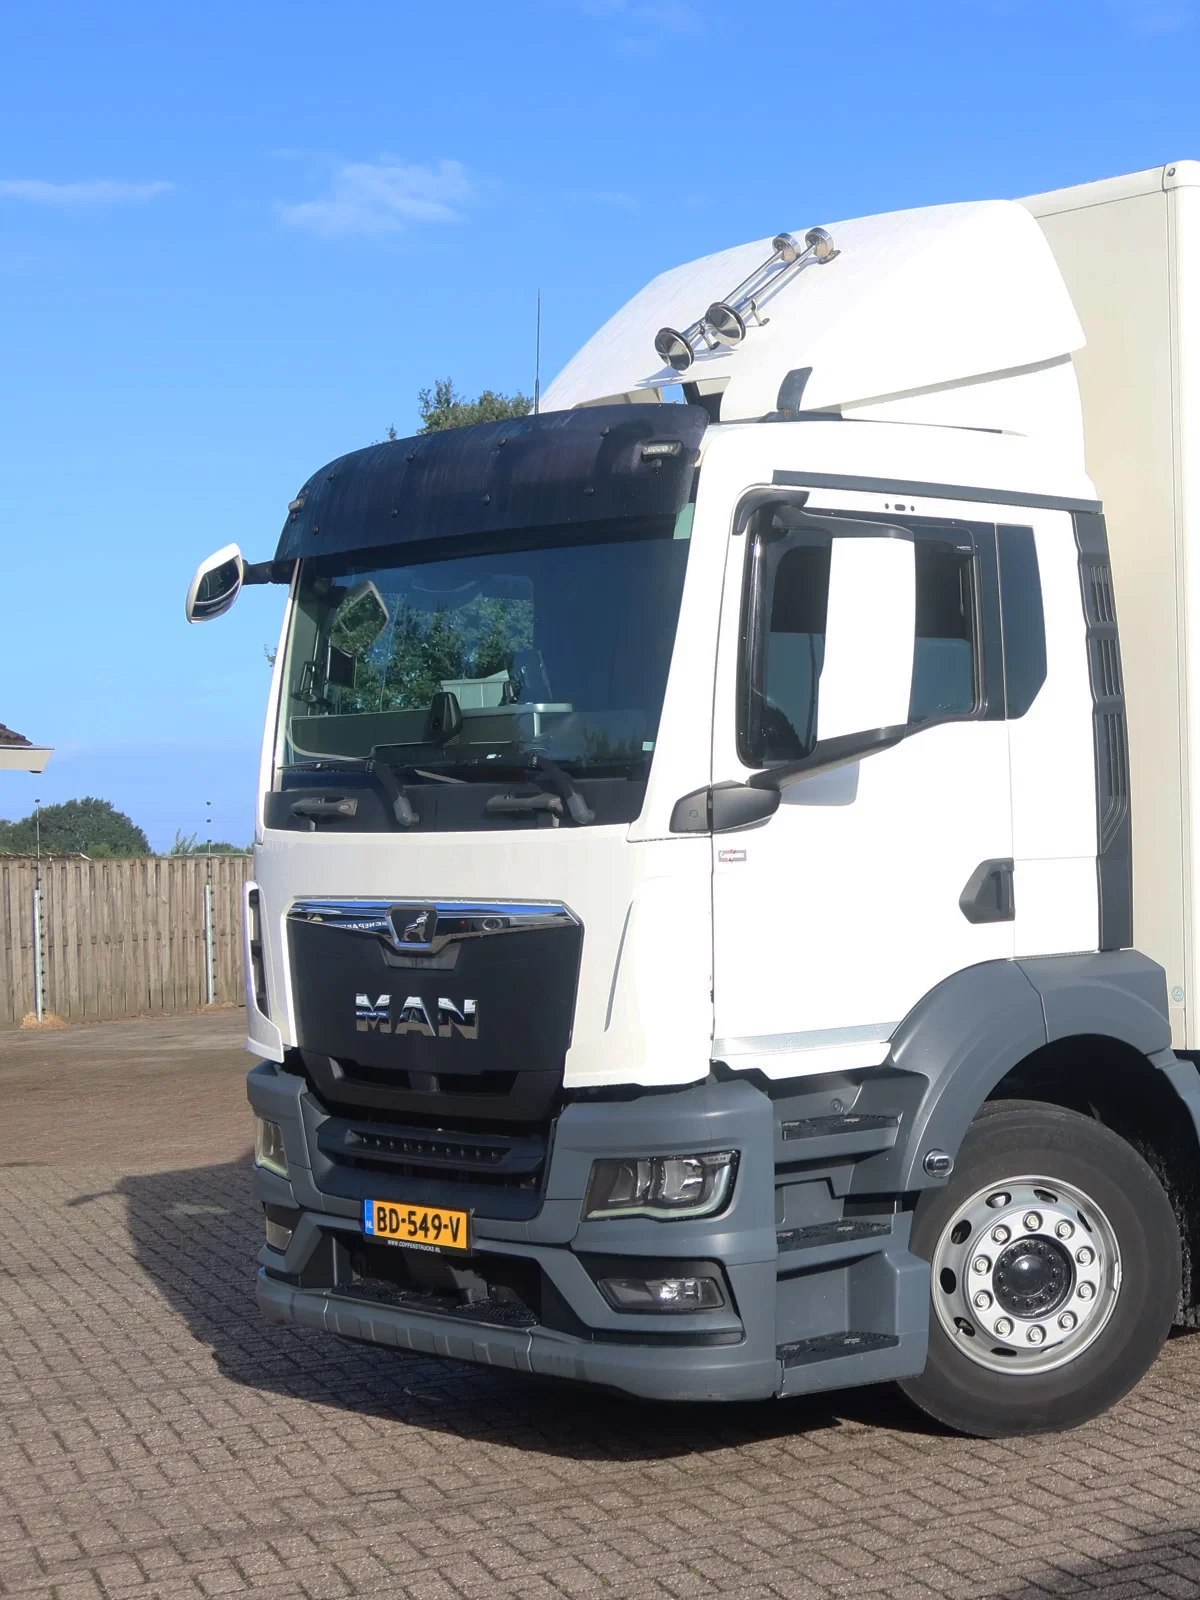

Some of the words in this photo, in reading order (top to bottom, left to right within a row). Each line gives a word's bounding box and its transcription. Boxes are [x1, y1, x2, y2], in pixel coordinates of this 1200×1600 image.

[355, 993, 479, 1040] MAN
[366, 1220, 374, 1230] NL
[376, 1206, 461, 1243] BD-549-V
[387, 1239, 441, 1253] WWW.COPPENSTRUCKS.NL
